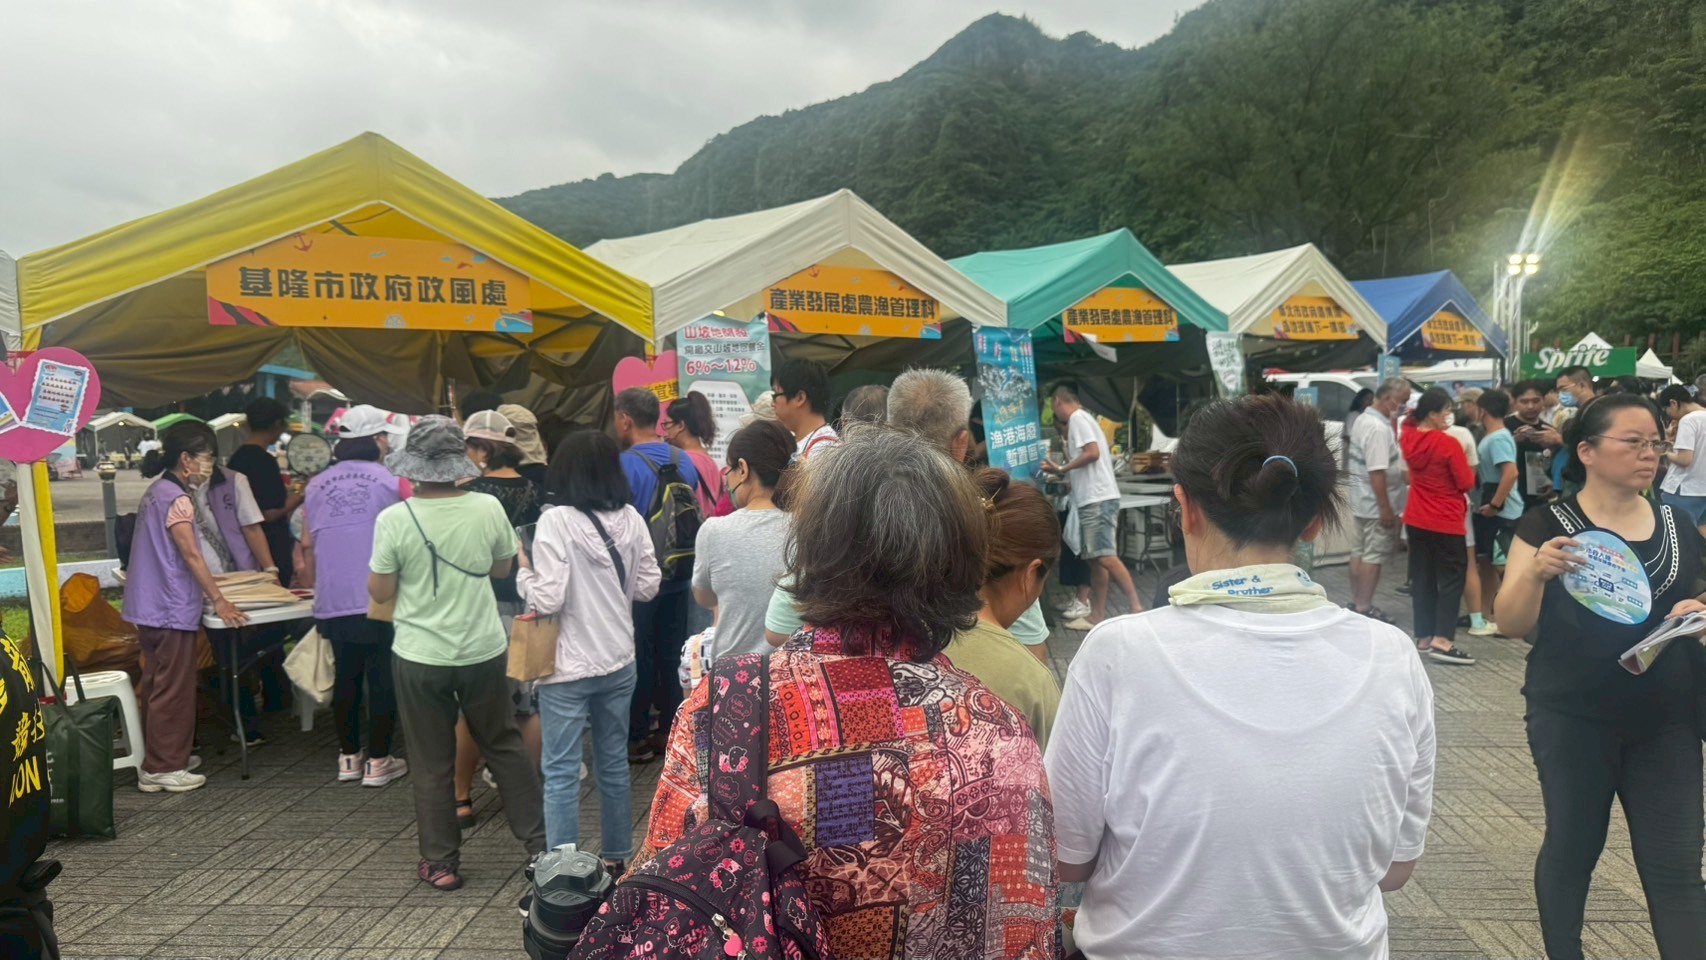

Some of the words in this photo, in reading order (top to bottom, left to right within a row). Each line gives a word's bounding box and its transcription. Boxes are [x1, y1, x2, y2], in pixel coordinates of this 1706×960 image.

[239, 267, 507, 306] 基隆市政府政風處
[770, 288, 935, 319] 產業發展處農漁管理科
[1534, 345, 1610, 374] Sprite
[990, 422, 1037, 449] 漁港海廢
[1006, 443, 1038, 467] 暫置區
[1212, 577, 1247, 590] Sister
[1251, 575, 1261, 583] &
